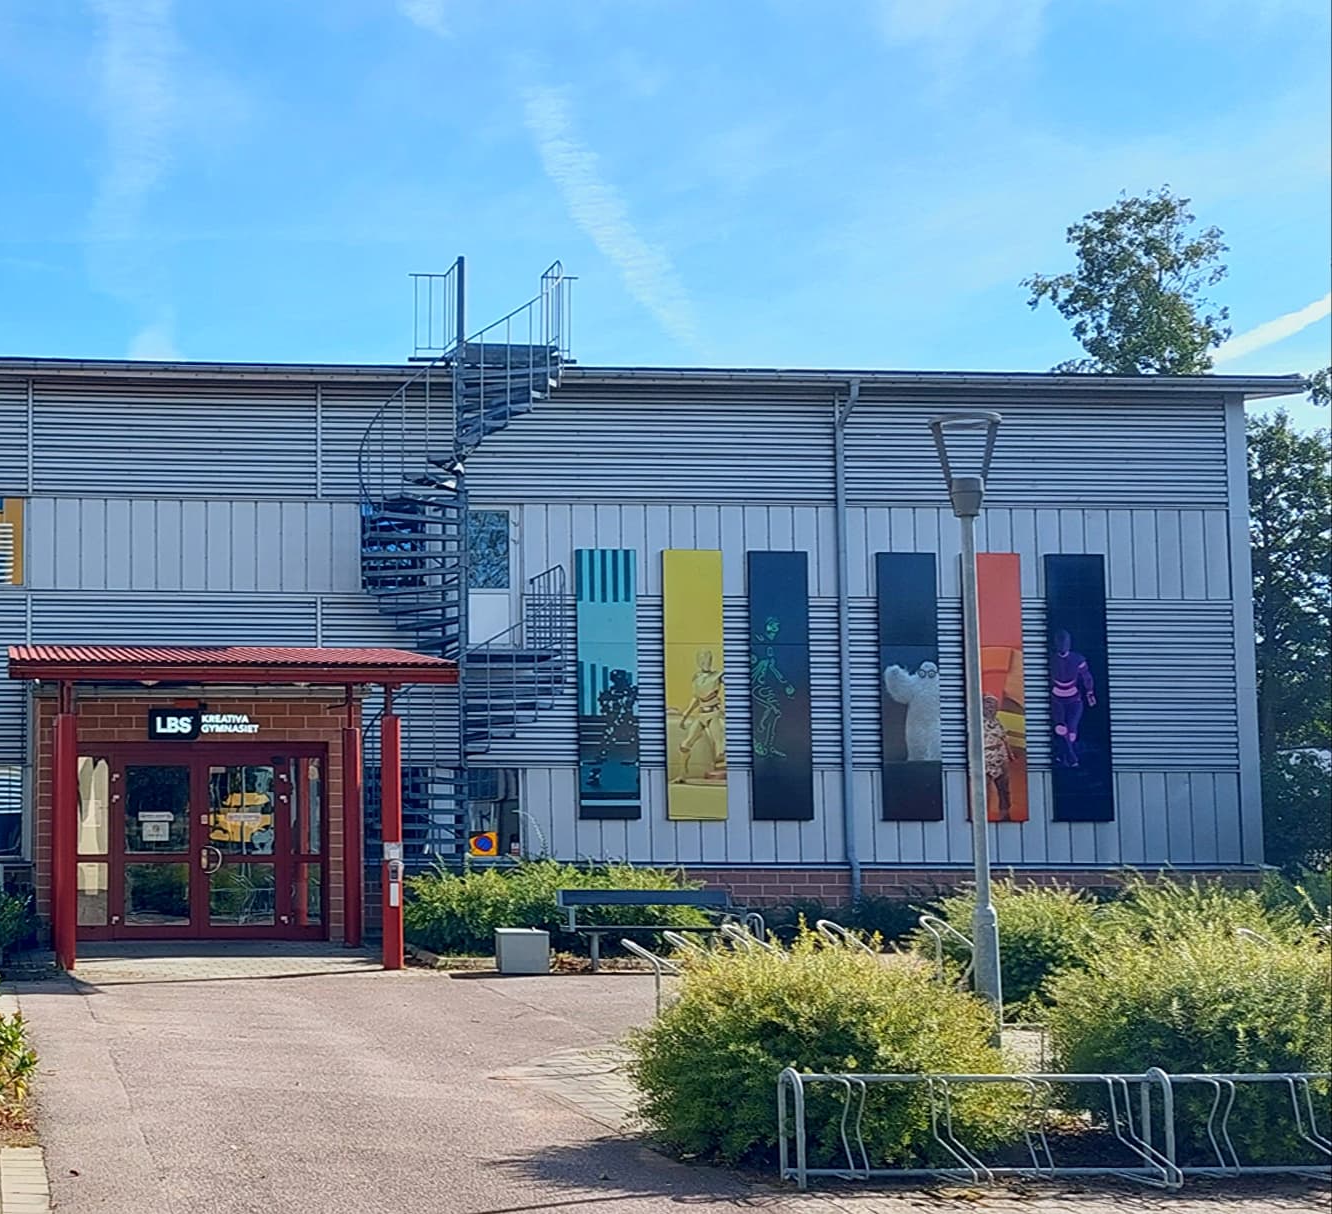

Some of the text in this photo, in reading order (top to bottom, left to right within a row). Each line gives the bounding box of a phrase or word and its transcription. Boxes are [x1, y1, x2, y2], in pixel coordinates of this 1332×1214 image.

[201, 714, 250, 723] KREATIVA
[156, 716, 192, 733] LBS
[200, 724, 260, 733] GYMNASIET
